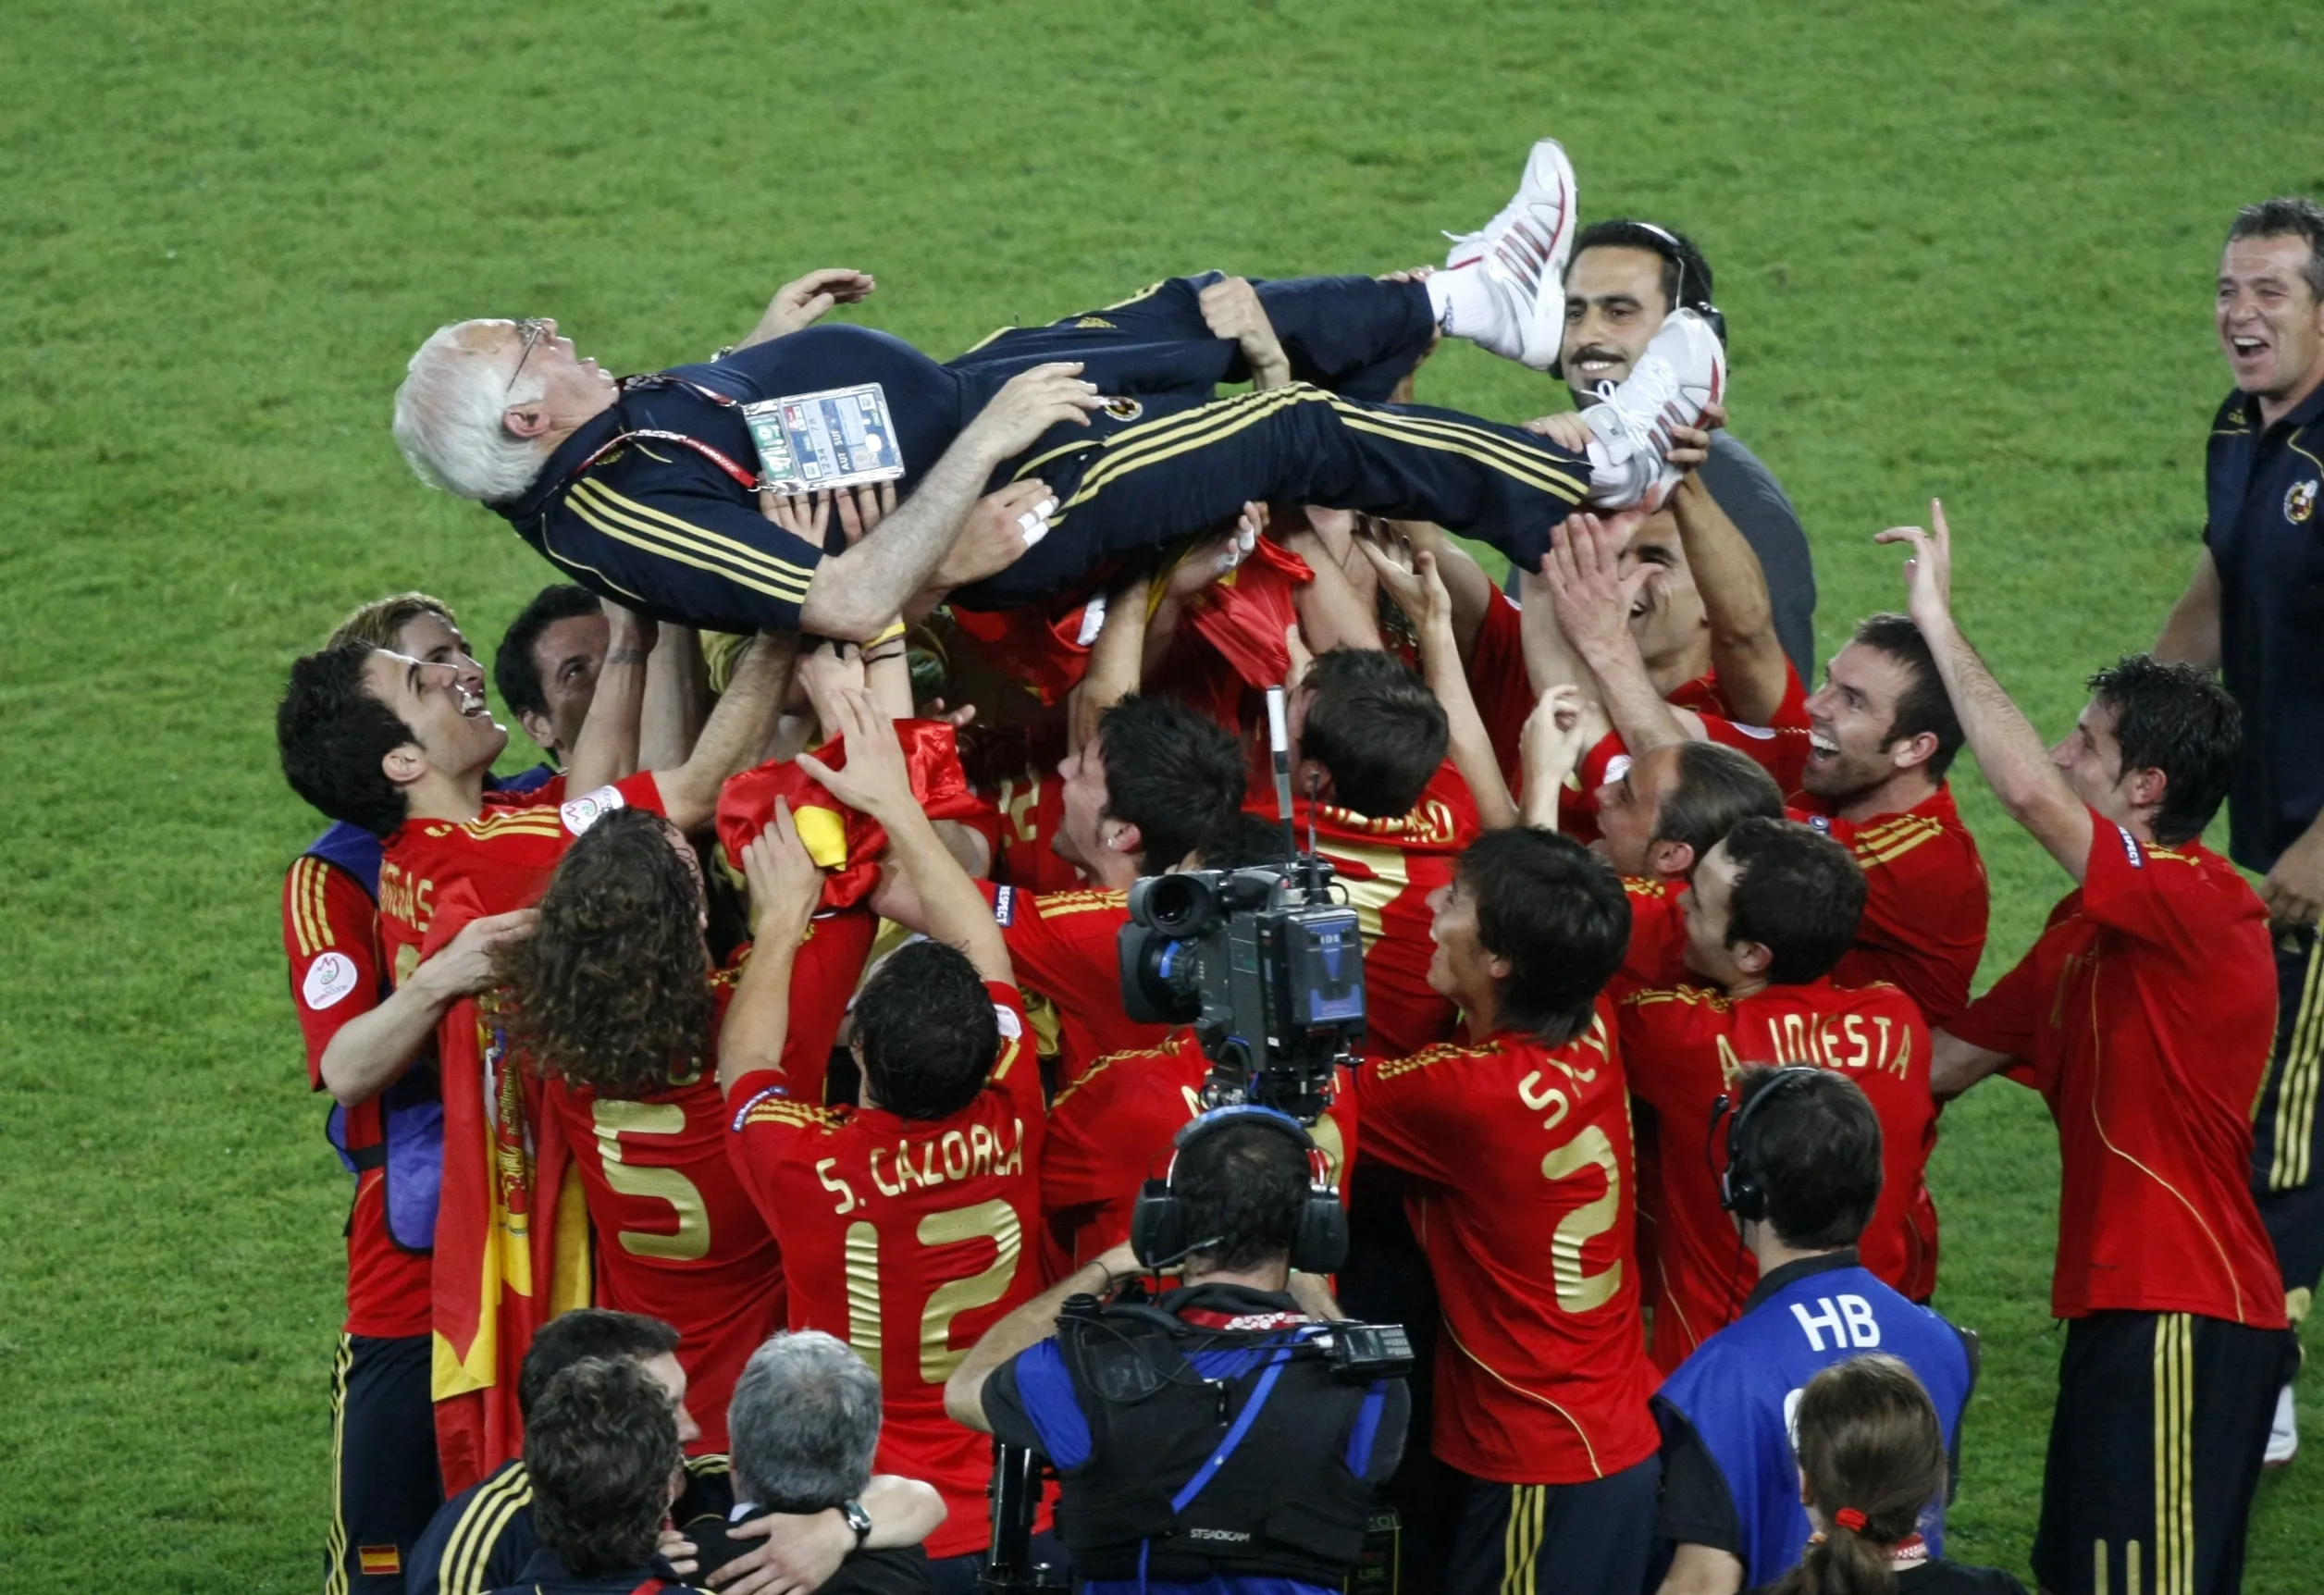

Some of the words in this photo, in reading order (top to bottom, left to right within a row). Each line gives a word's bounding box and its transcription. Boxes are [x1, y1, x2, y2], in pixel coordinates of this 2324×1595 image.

[837, 452, 850, 470] AUT
[1768, 1012, 1911, 1081] INIESTA
[591, 1098, 711, 1262] 5
[815, 1157, 866, 1215] S.
[870, 1118, 1024, 1197] CAZORLA
[845, 1198, 1022, 1385] 12
[1789, 1293, 1881, 1353] HB
[1190, 1527, 1251, 1543] STEADICAM
